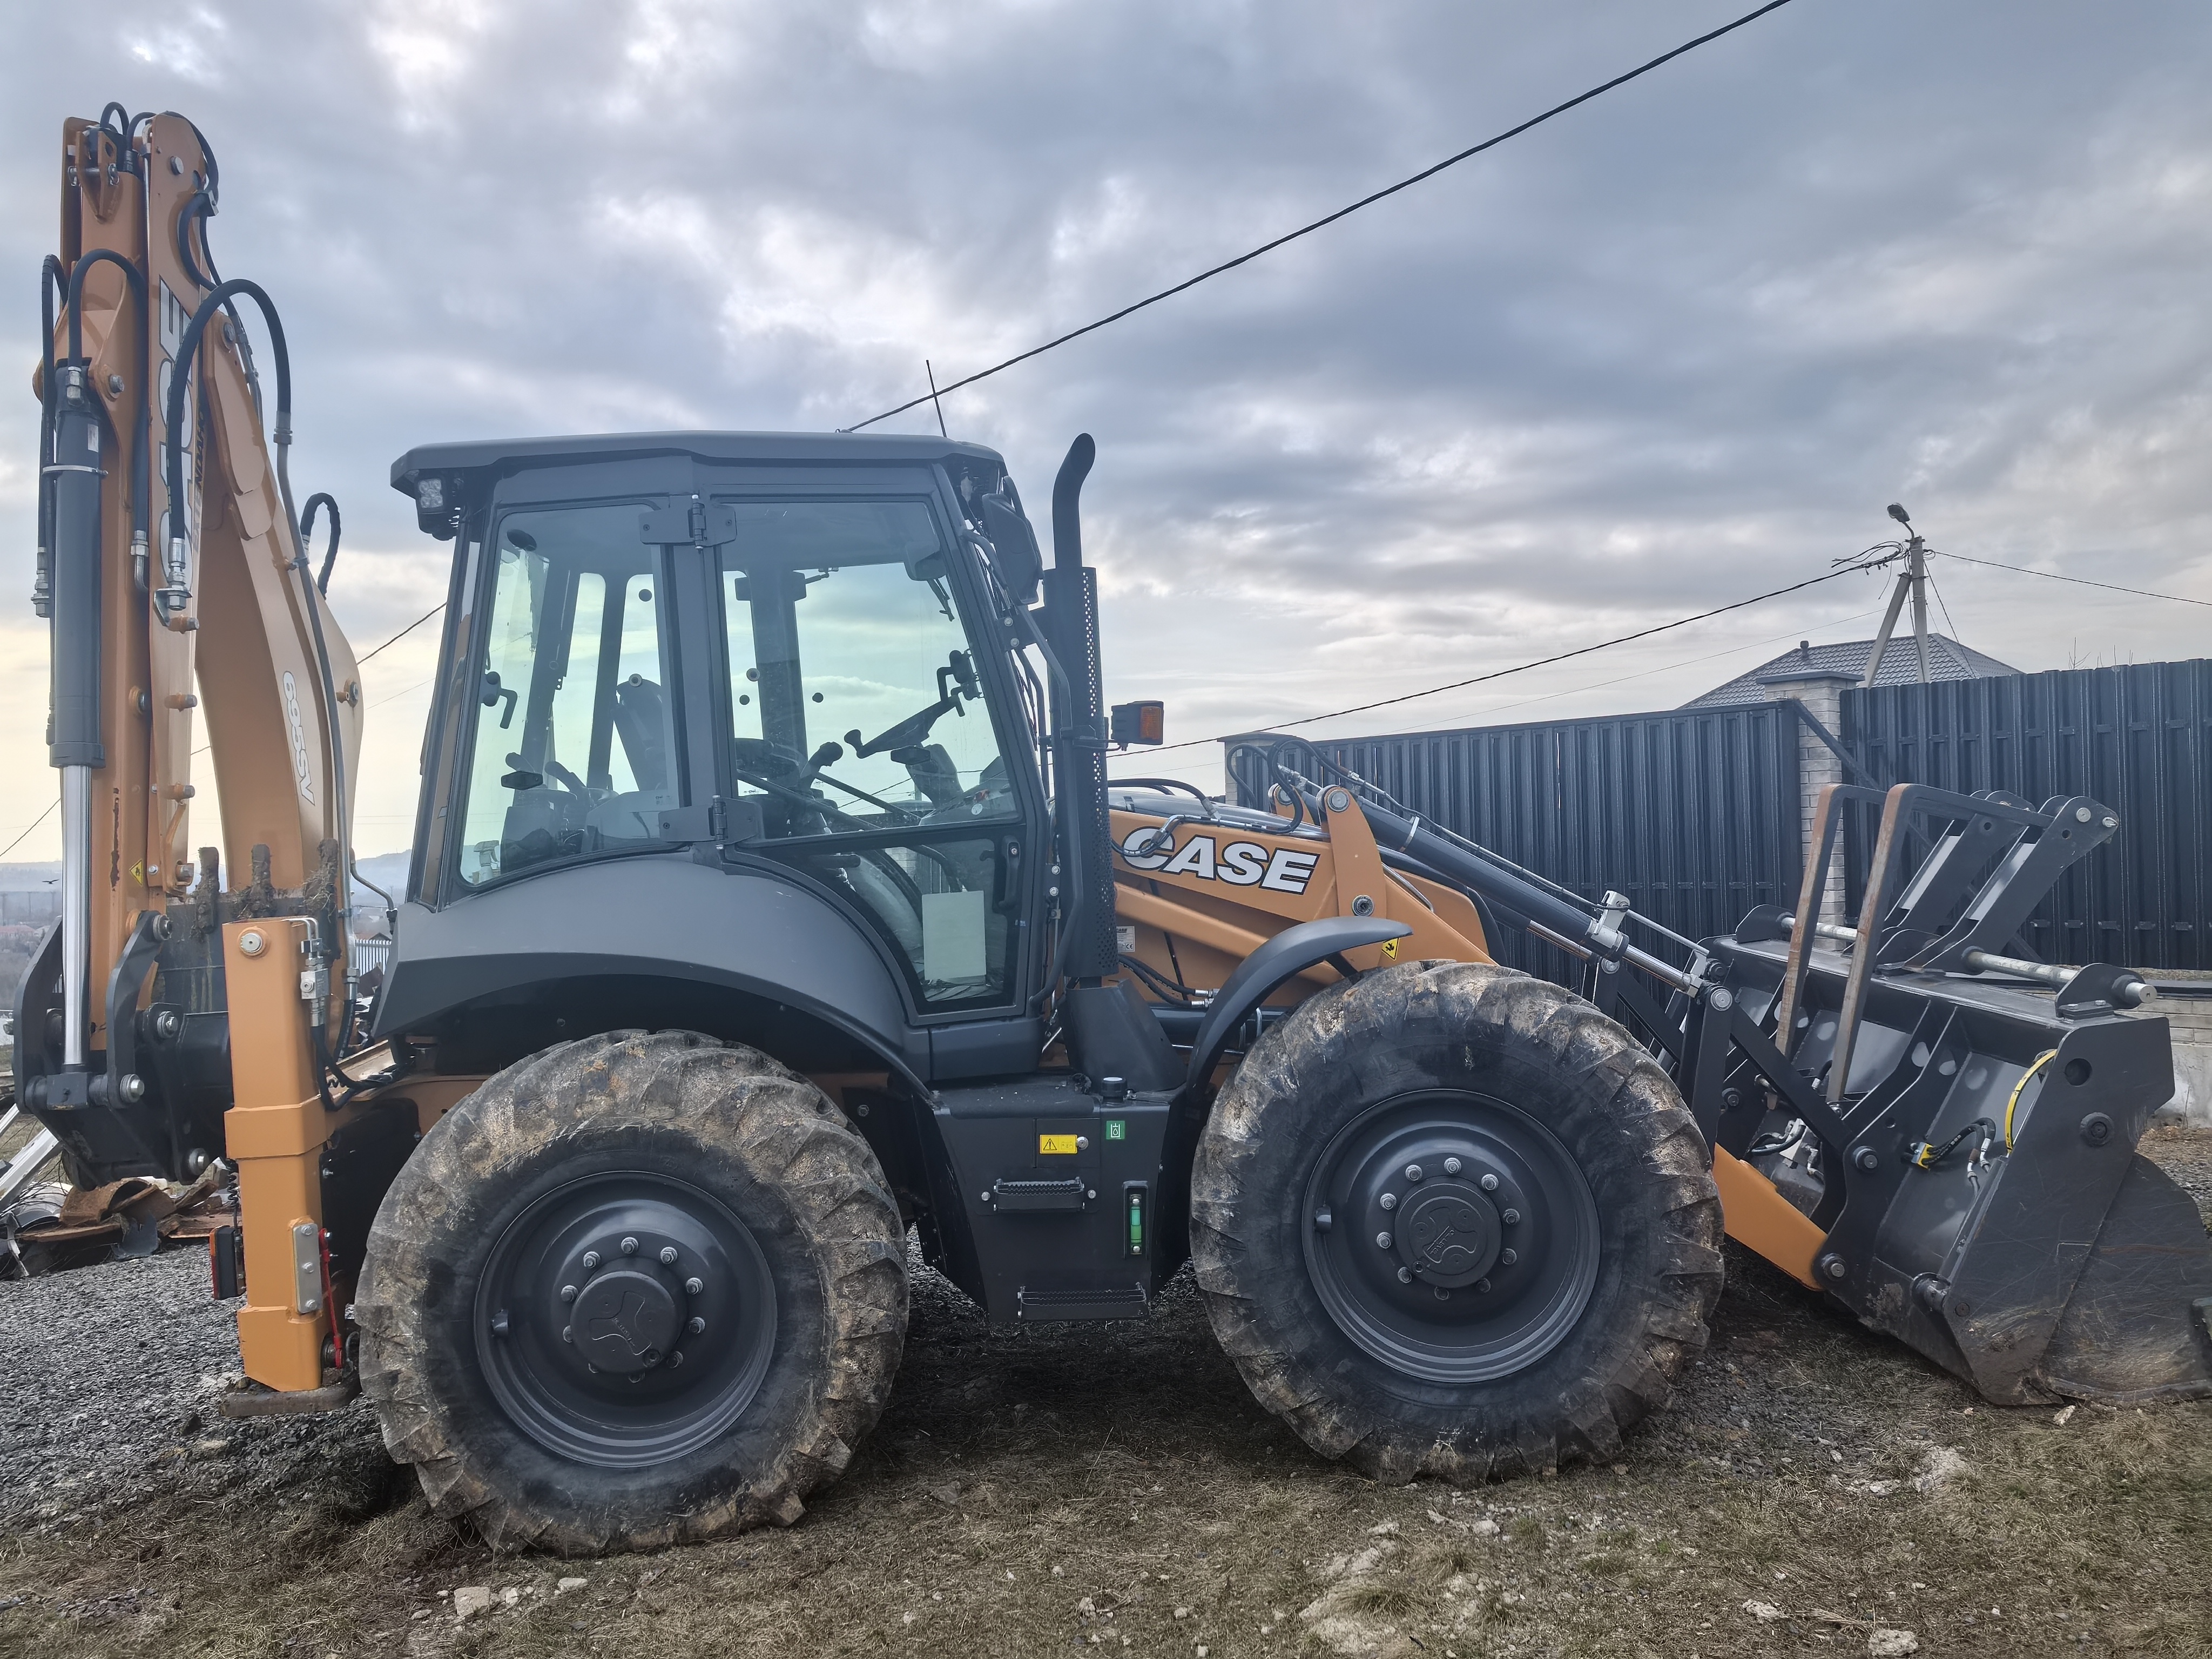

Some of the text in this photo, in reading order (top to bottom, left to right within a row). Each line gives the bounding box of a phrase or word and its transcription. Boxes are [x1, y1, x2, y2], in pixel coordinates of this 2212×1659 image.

[193, 404, 206, 554] EXTENDAHO
[283, 671, 315, 807] 695SV
[1122, 826, 1320, 895] CASE
